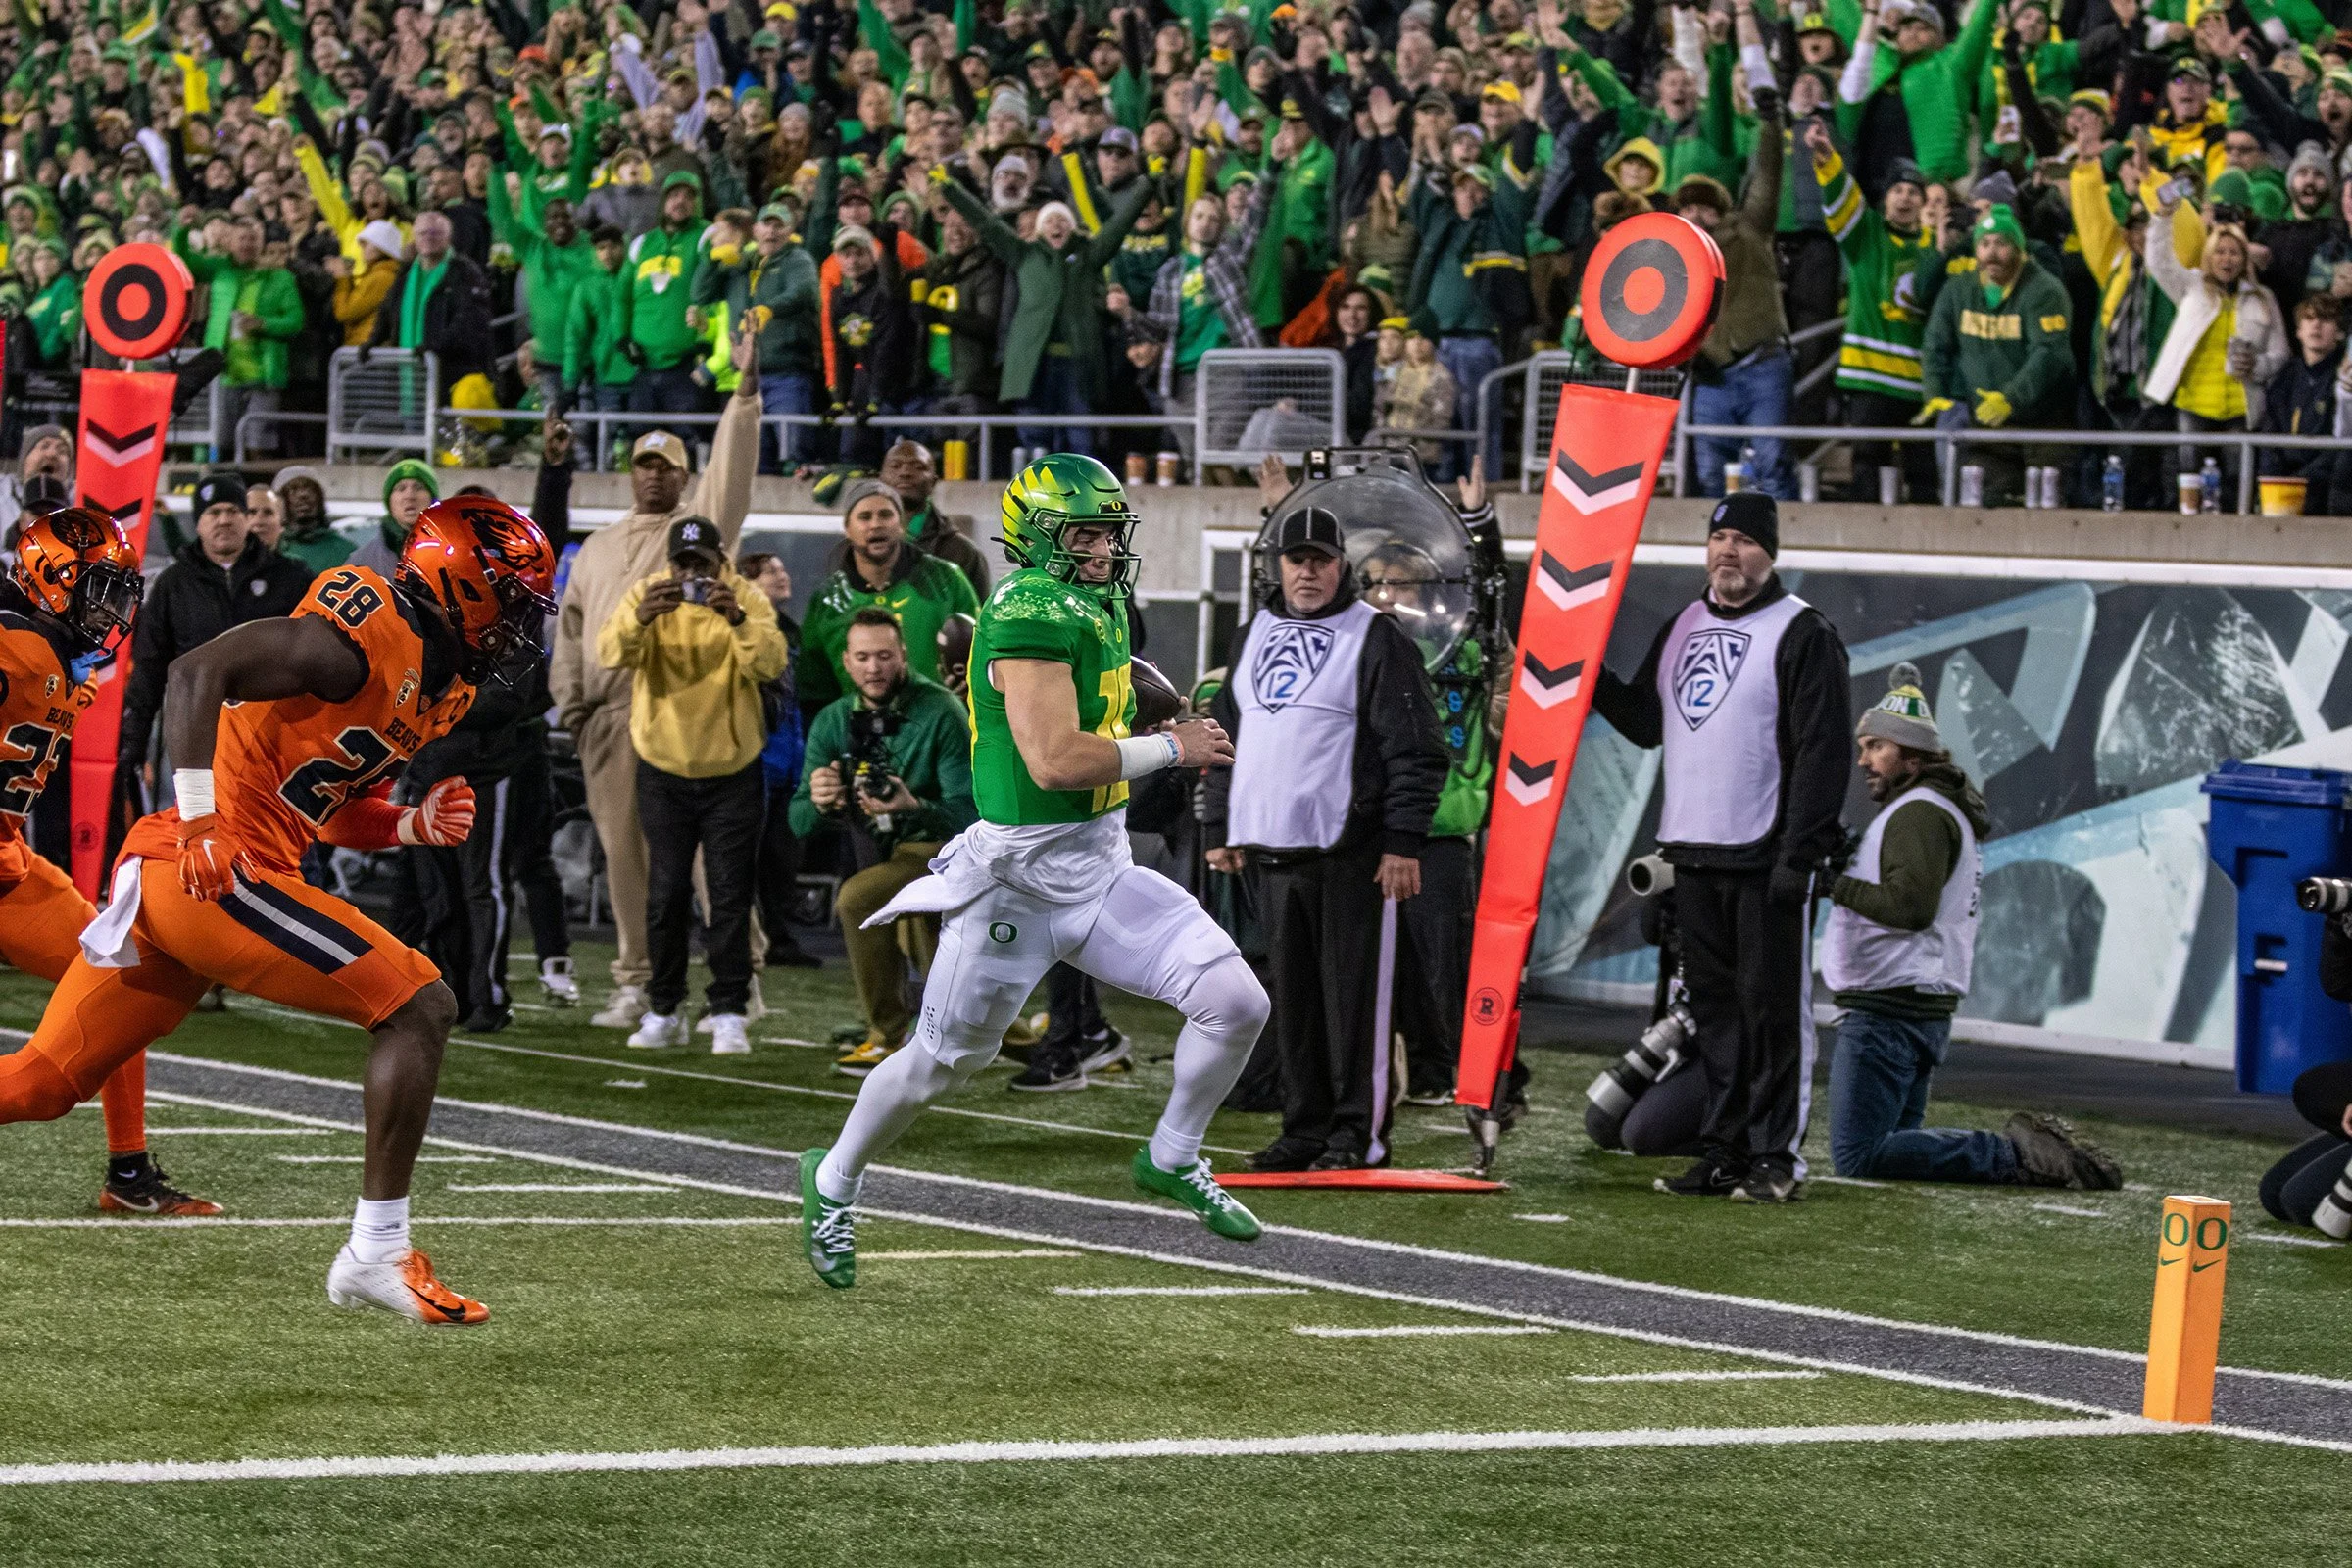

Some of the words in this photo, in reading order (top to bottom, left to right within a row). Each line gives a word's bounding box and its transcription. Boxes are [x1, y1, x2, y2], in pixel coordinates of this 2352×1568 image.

[1111, 500, 1122, 512] O
[315, 565, 386, 629] 28
[1115, 627, 1123, 643] O
[1255, 627, 1331, 676] PAC
[1676, 634, 1747, 683] PAC
[1267, 671, 1298, 699] 12
[1687, 679, 1715, 707] 12
[45, 706, 75, 730] BEAVS
[383, 716, 423, 754] BEAVS
[988, 921, 1019, 944] O
[1480, 996, 1494, 1016] R
[2163, 1212, 2190, 1247] O
[2196, 1217, 2229, 1251] O
